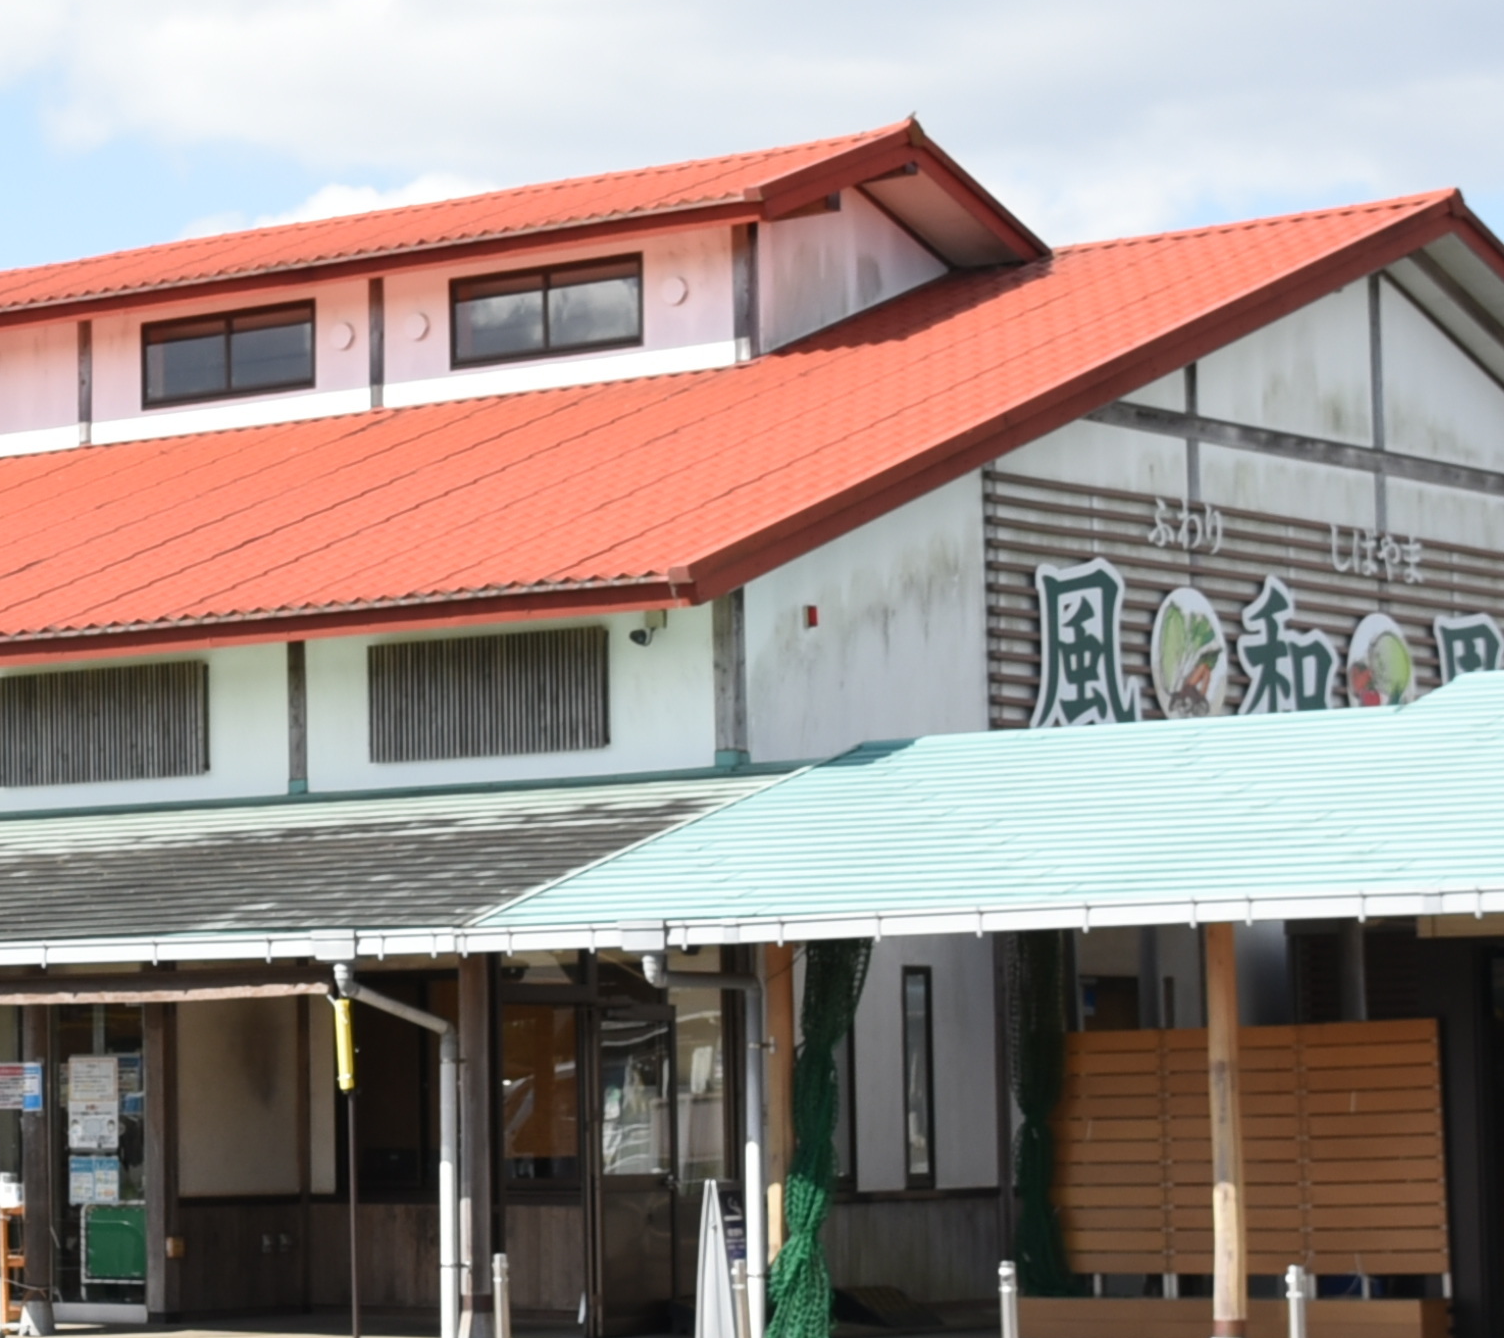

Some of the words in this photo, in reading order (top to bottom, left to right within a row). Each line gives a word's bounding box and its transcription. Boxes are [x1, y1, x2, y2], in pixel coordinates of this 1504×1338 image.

[1147, 496, 1223, 555] ふわり
[1330, 523, 1424, 584] しばやま
